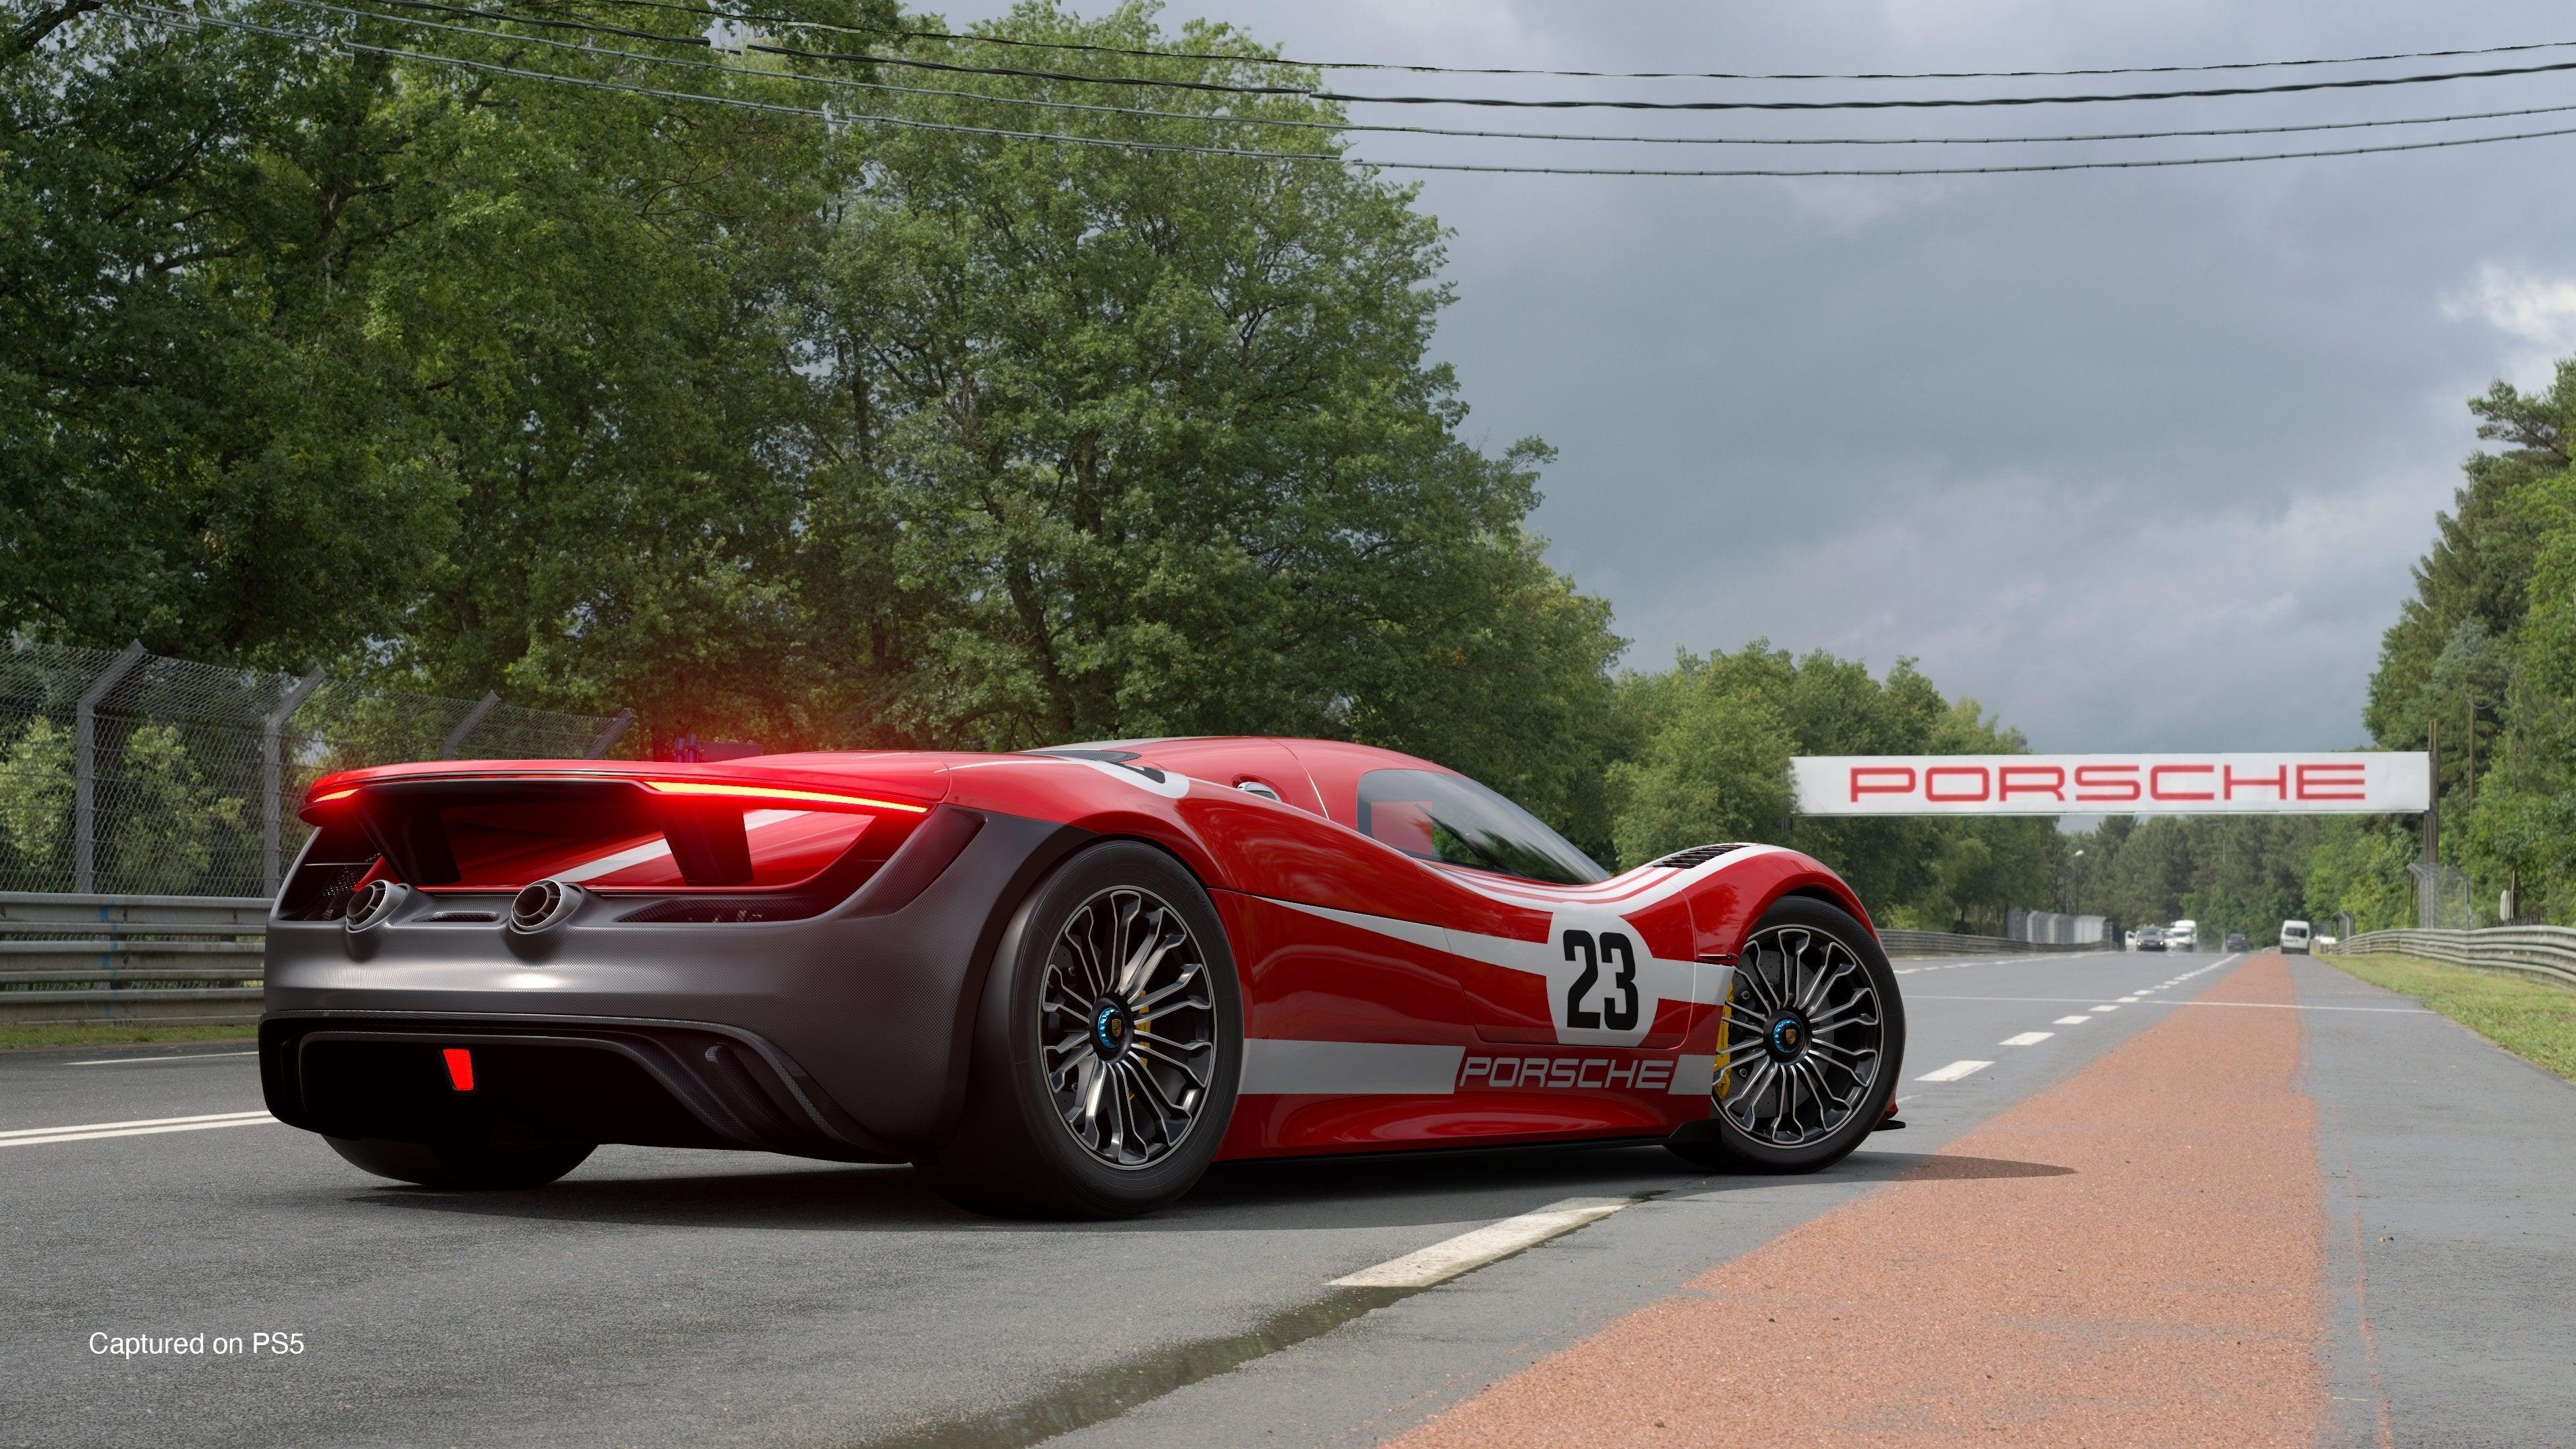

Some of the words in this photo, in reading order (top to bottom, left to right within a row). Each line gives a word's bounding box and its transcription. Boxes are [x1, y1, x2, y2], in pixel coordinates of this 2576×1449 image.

[1850, 763, 2365, 802] PORSCHE
[1562, 929, 1639, 1031] 23
[1459, 1057, 1673, 1089] PORSCHE
